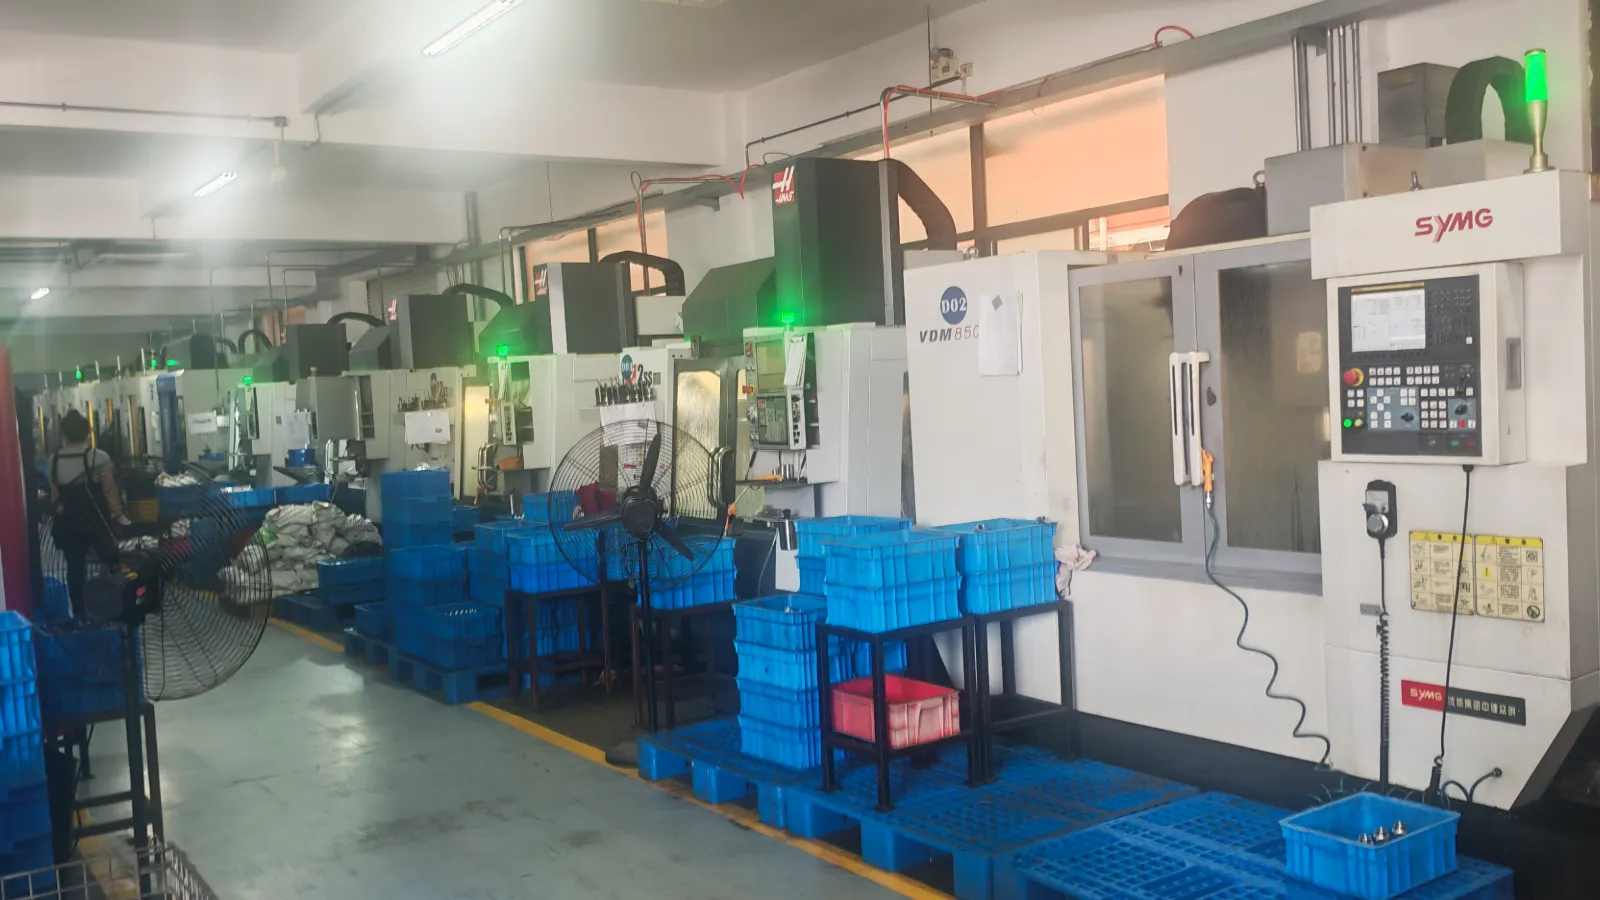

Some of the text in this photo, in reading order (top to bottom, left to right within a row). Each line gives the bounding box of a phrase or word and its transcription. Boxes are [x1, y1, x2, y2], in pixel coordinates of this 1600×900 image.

[1414, 208, 1493, 243] SYMG
[941, 297, 966, 313] D02
[1410, 688, 1442, 701] SYMG
